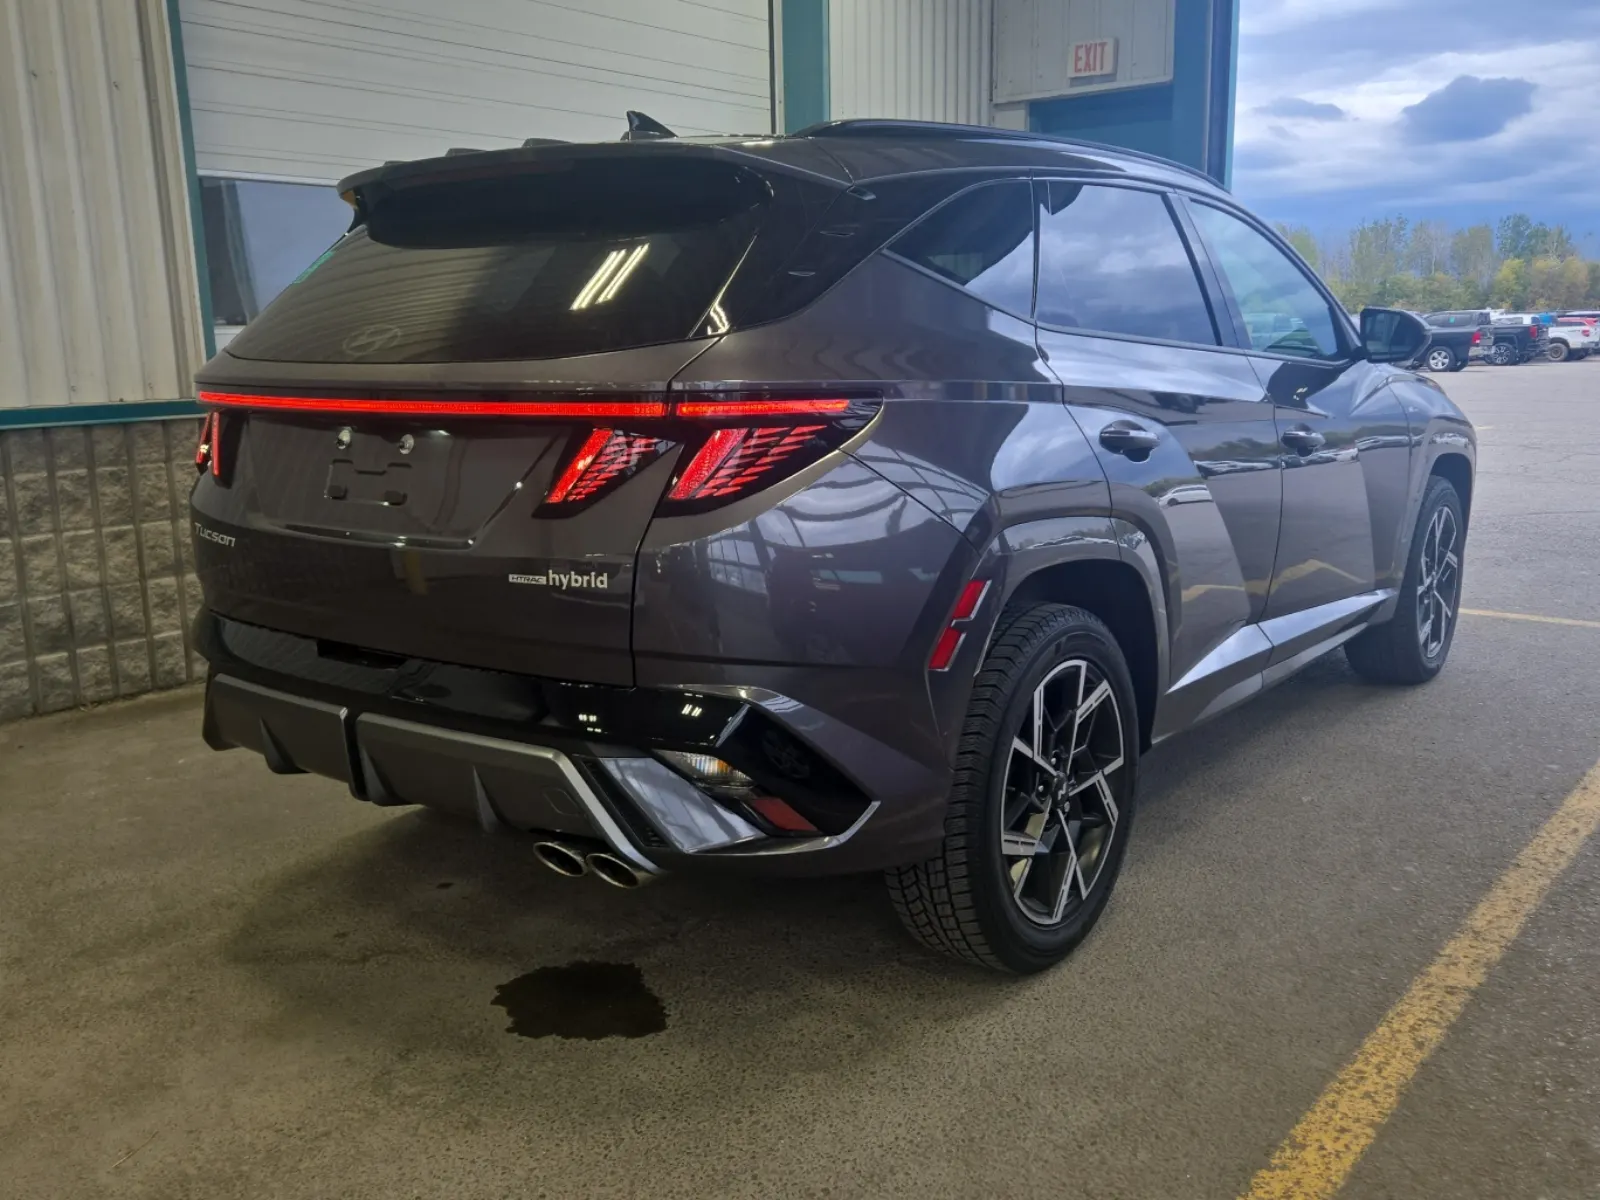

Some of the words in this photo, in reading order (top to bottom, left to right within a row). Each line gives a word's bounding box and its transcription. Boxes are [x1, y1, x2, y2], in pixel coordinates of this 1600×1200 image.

[1074, 41, 1108, 73] EXIT
[509, 574, 545, 585] HTRAC
[548, 569, 608, 590] hybrid
